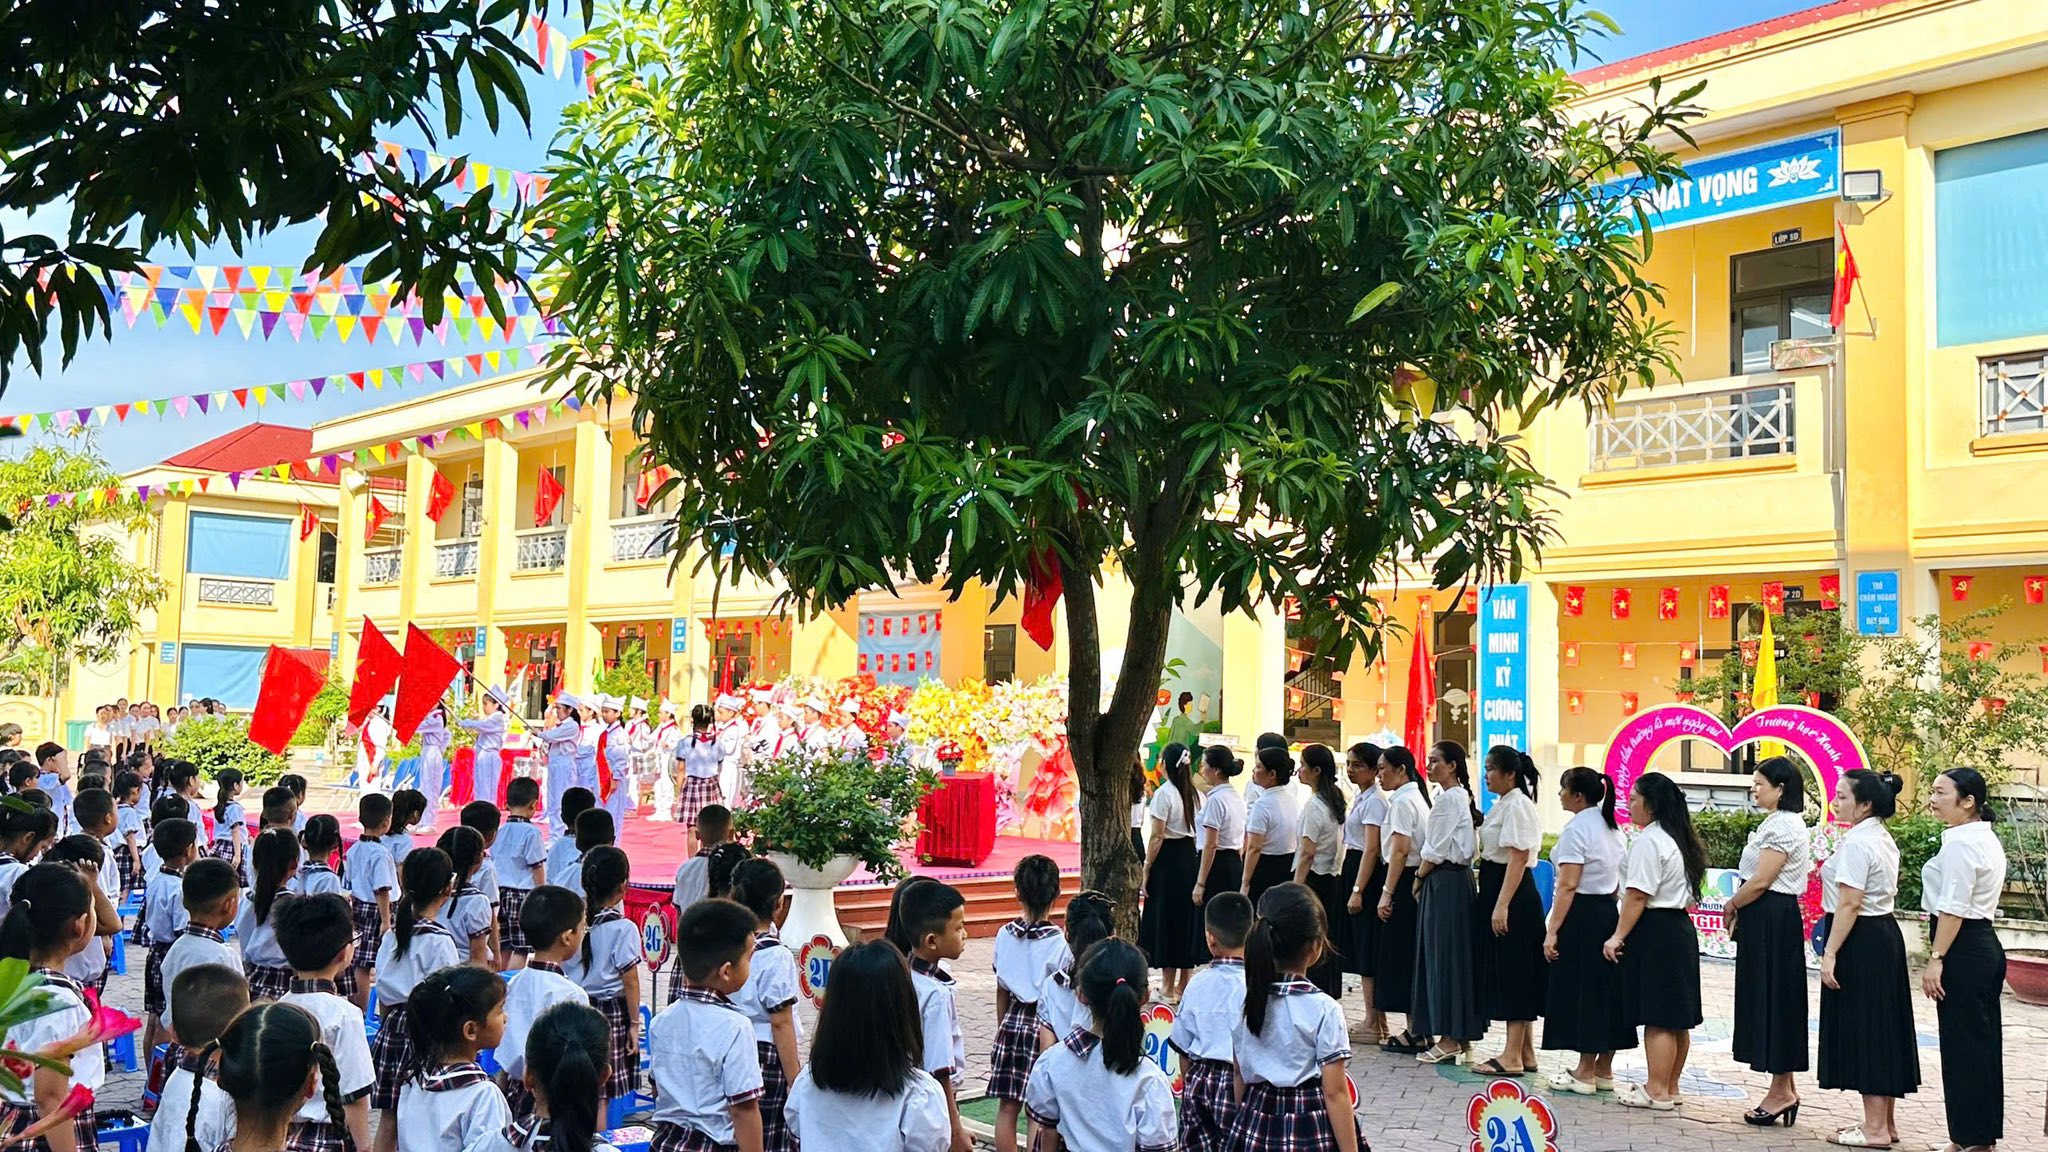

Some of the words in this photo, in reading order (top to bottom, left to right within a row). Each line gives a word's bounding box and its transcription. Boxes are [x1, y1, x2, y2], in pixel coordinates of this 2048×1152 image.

[1699, 167, 1758, 207] VỌNG
[1493, 595, 1516, 620] VĂN
[1488, 632, 1519, 653] MINH
[1495, 657, 1511, 688] KỶ
[645, 924, 662, 952] 2G
[1487, 1116, 1535, 1152] 2A
